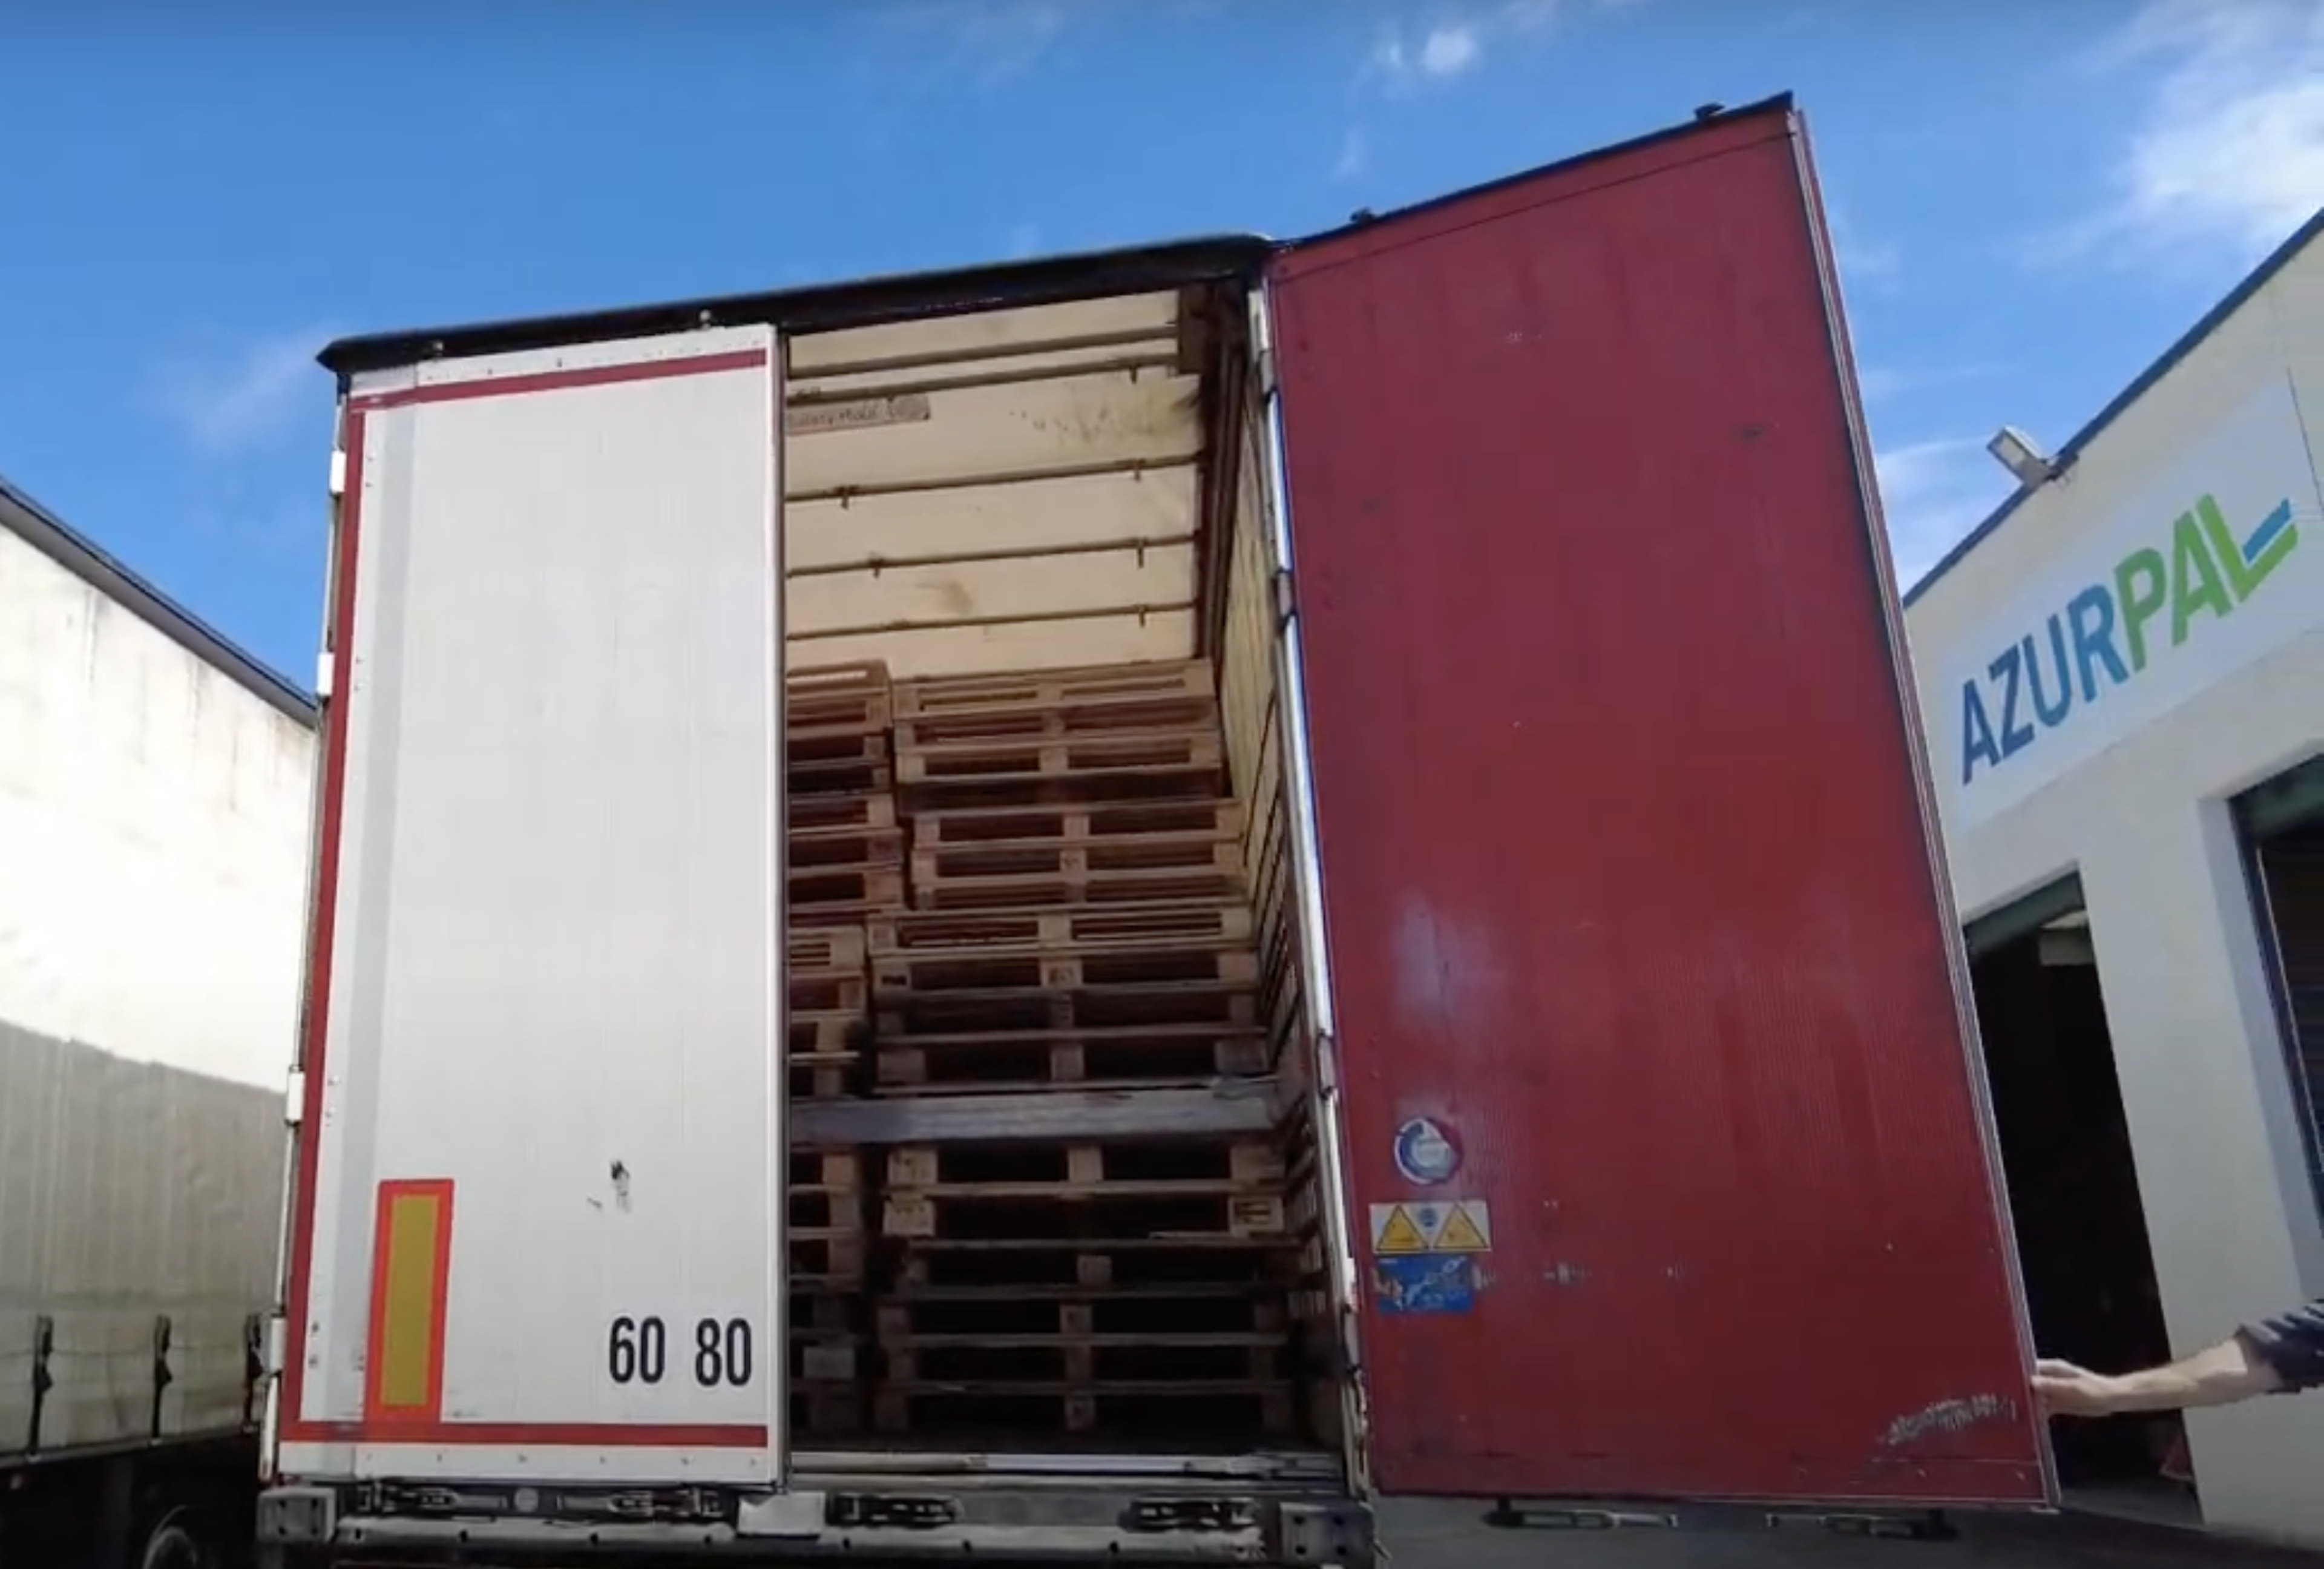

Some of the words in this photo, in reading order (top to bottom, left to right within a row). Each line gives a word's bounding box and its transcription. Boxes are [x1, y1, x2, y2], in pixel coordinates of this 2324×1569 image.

[1963, 493, 2298, 785] AZURPAL
[609, 1315, 665, 1383] 60
[695, 1317, 751, 1387] 80
